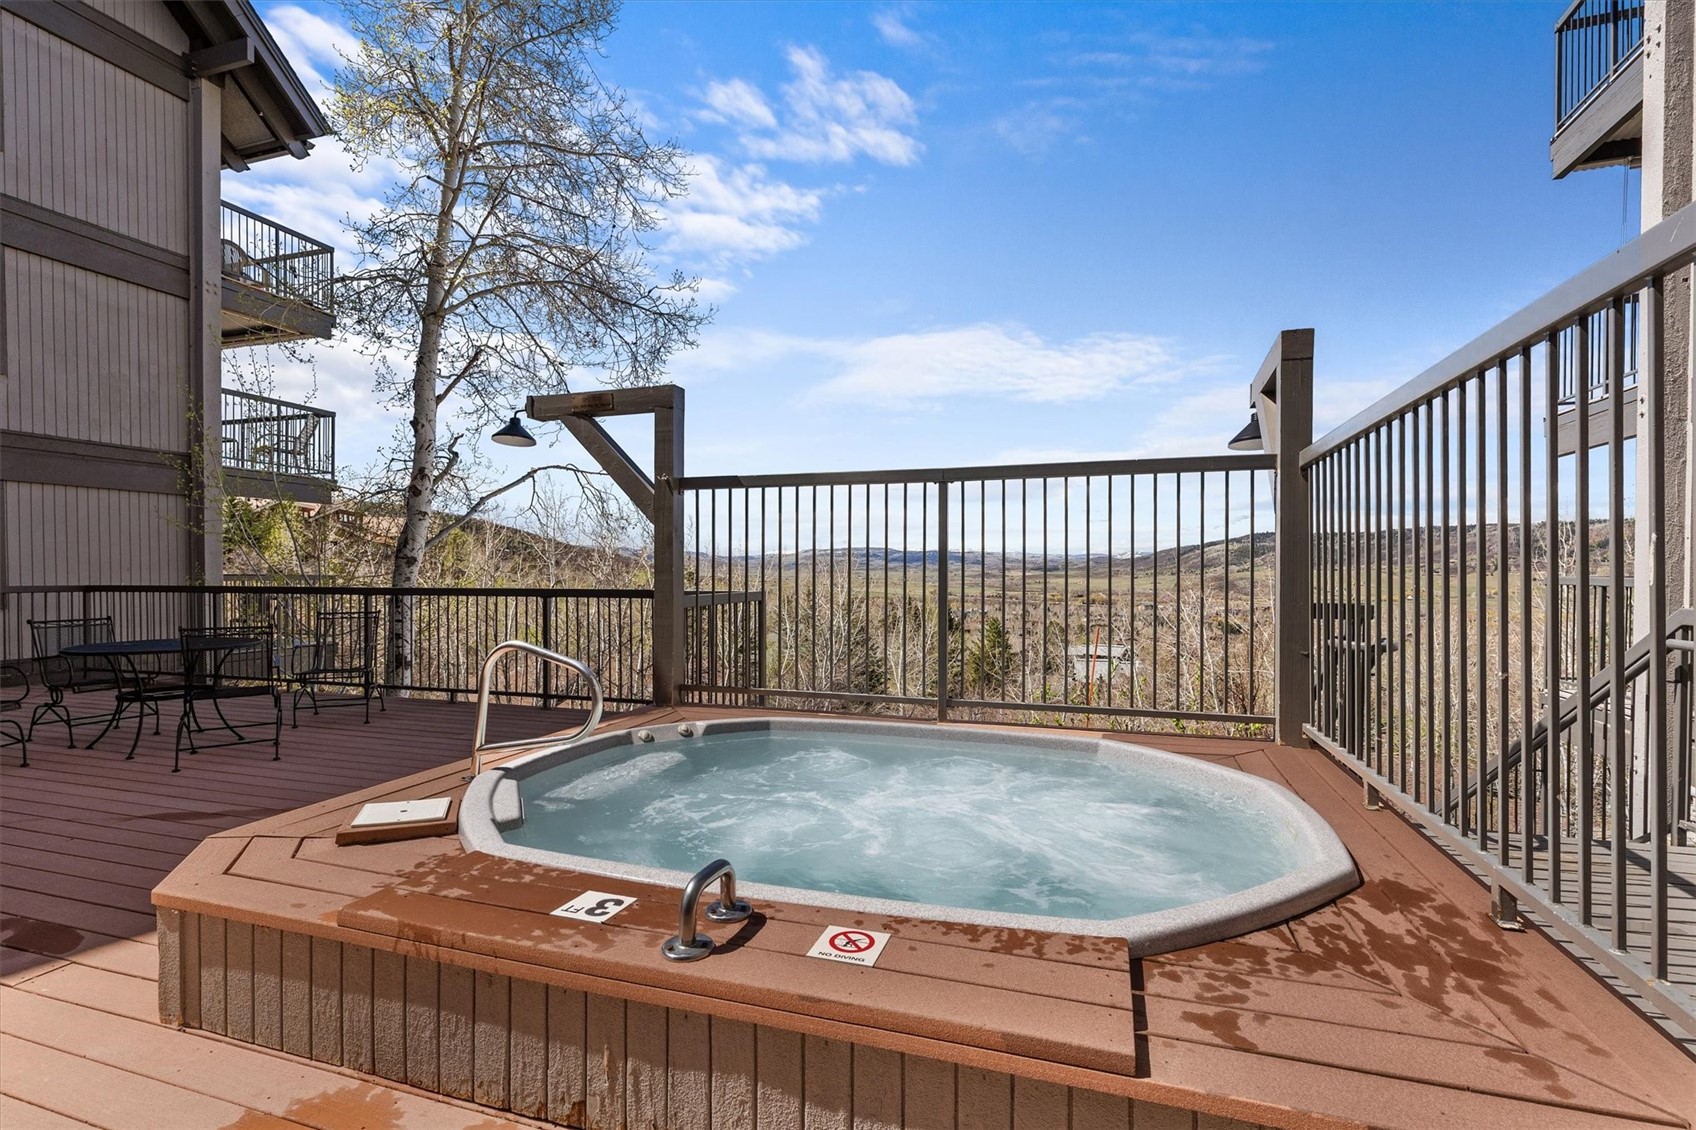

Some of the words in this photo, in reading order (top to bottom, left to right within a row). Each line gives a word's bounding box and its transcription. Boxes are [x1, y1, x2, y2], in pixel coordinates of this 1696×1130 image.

[561, 904, 585, 914] FT
[584, 898, 625, 917] 3
[834, 953, 865, 962] DIVING
